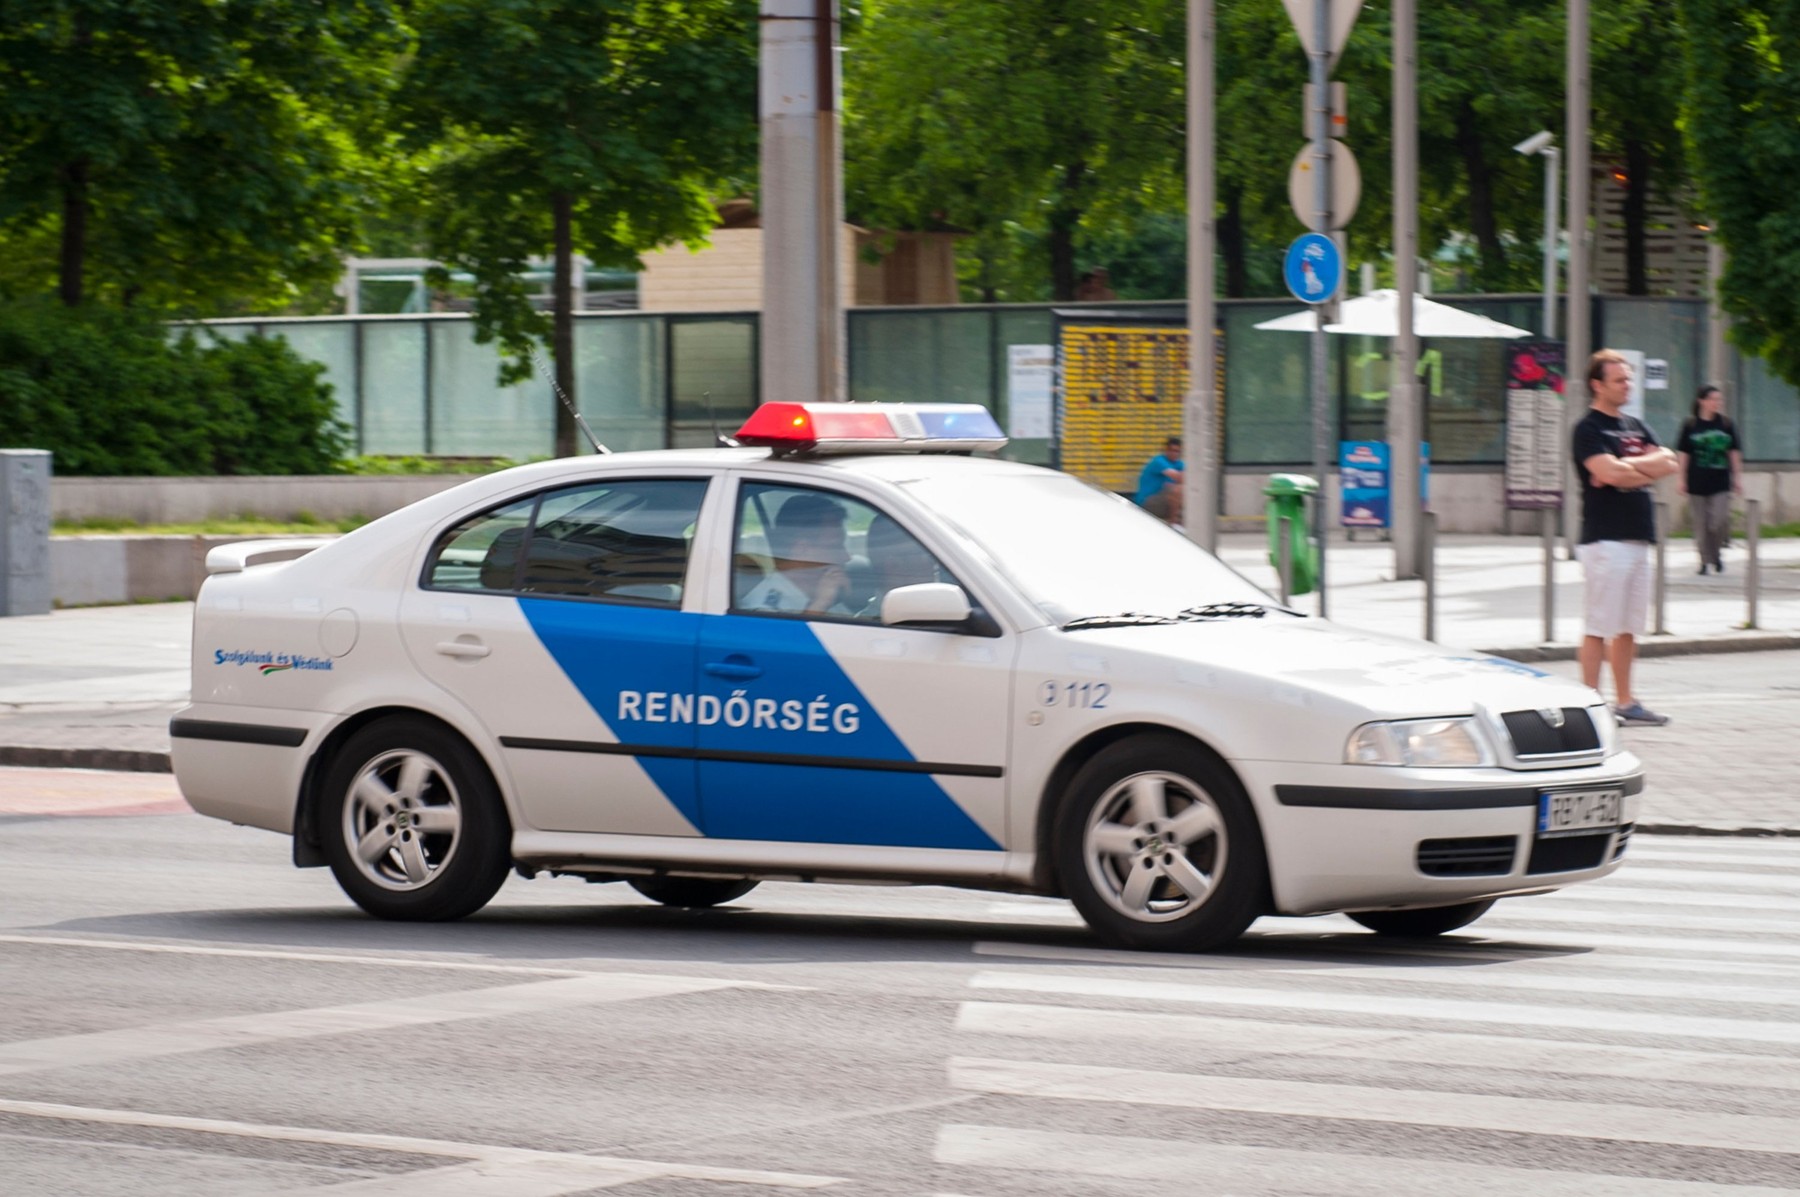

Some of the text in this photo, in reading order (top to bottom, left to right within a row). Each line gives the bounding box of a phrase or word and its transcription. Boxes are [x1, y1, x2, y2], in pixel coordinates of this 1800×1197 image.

[276, 652, 289, 665] és
[1064, 682, 1112, 708] 112
[618, 689, 860, 734] RENDŐRSÉG
